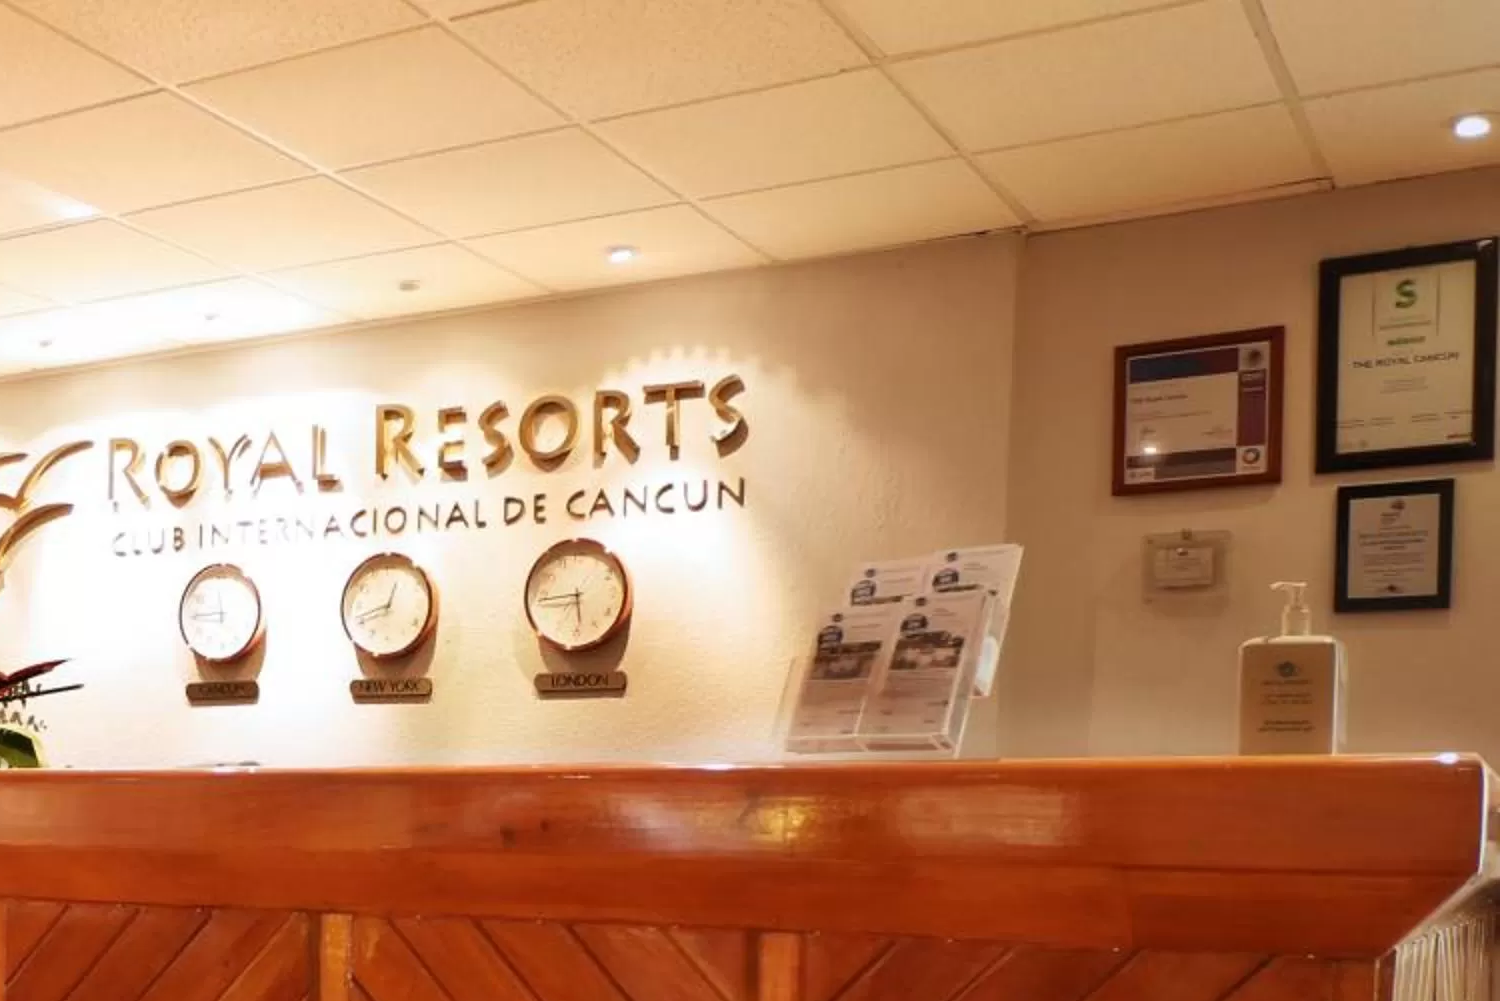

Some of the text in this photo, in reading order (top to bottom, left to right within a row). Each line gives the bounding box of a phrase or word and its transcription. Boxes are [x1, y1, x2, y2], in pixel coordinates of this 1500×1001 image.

[107, 373, 749, 510] ROYAL RESORTS
[112, 476, 746, 558] CLUB INTERNACIONAL DE CANCUN
[355, 680, 420, 694] NEW YORK
[550, 672, 609, 689] LONDON
